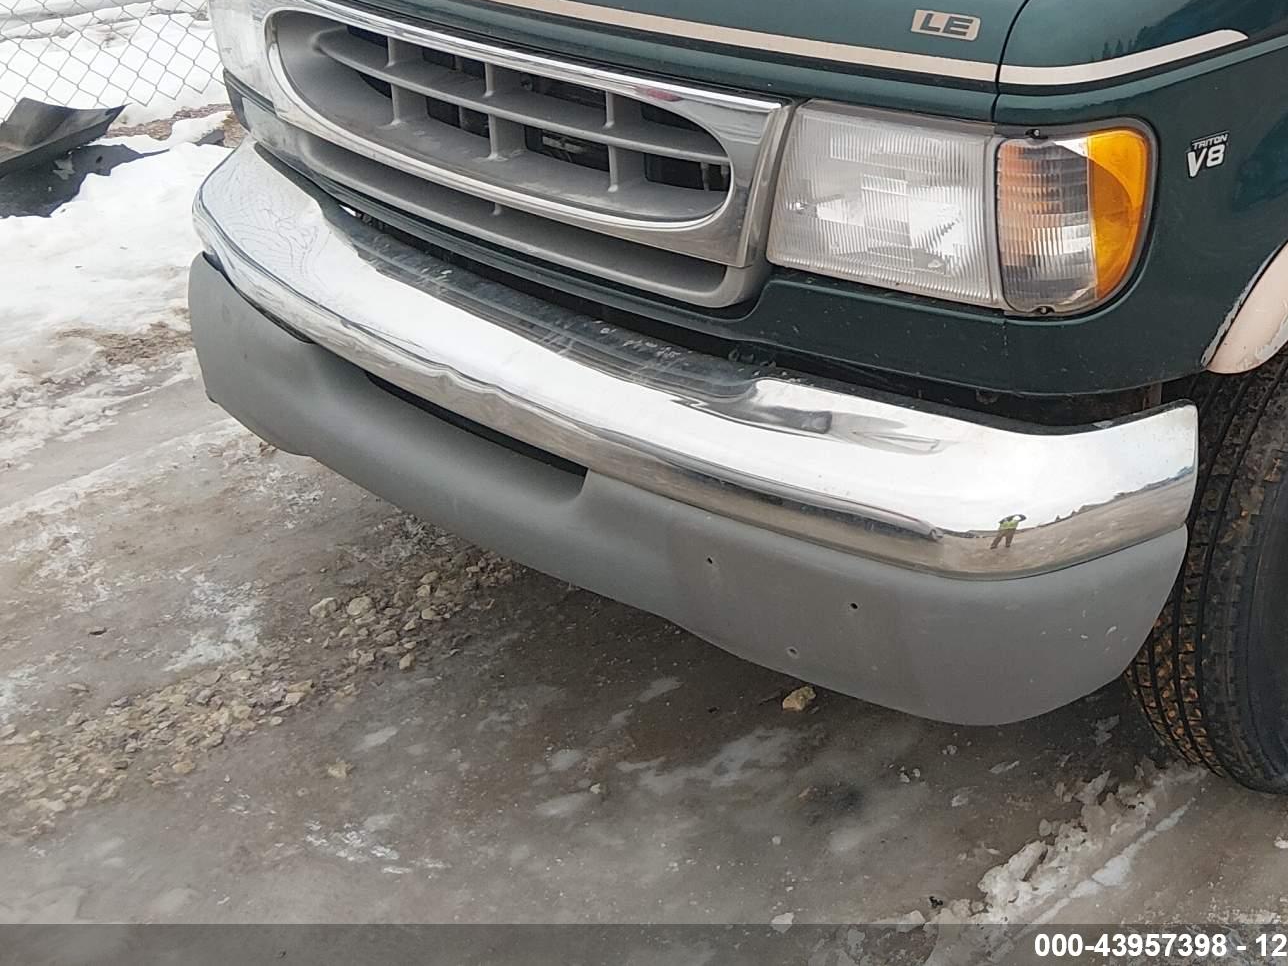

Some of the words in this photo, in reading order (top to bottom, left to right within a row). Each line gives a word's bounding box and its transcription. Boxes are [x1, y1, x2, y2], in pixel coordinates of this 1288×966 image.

[920, 13, 974, 36] LE
[1191, 133, 1228, 150] TRITON
[1187, 144, 1226, 178] V8
